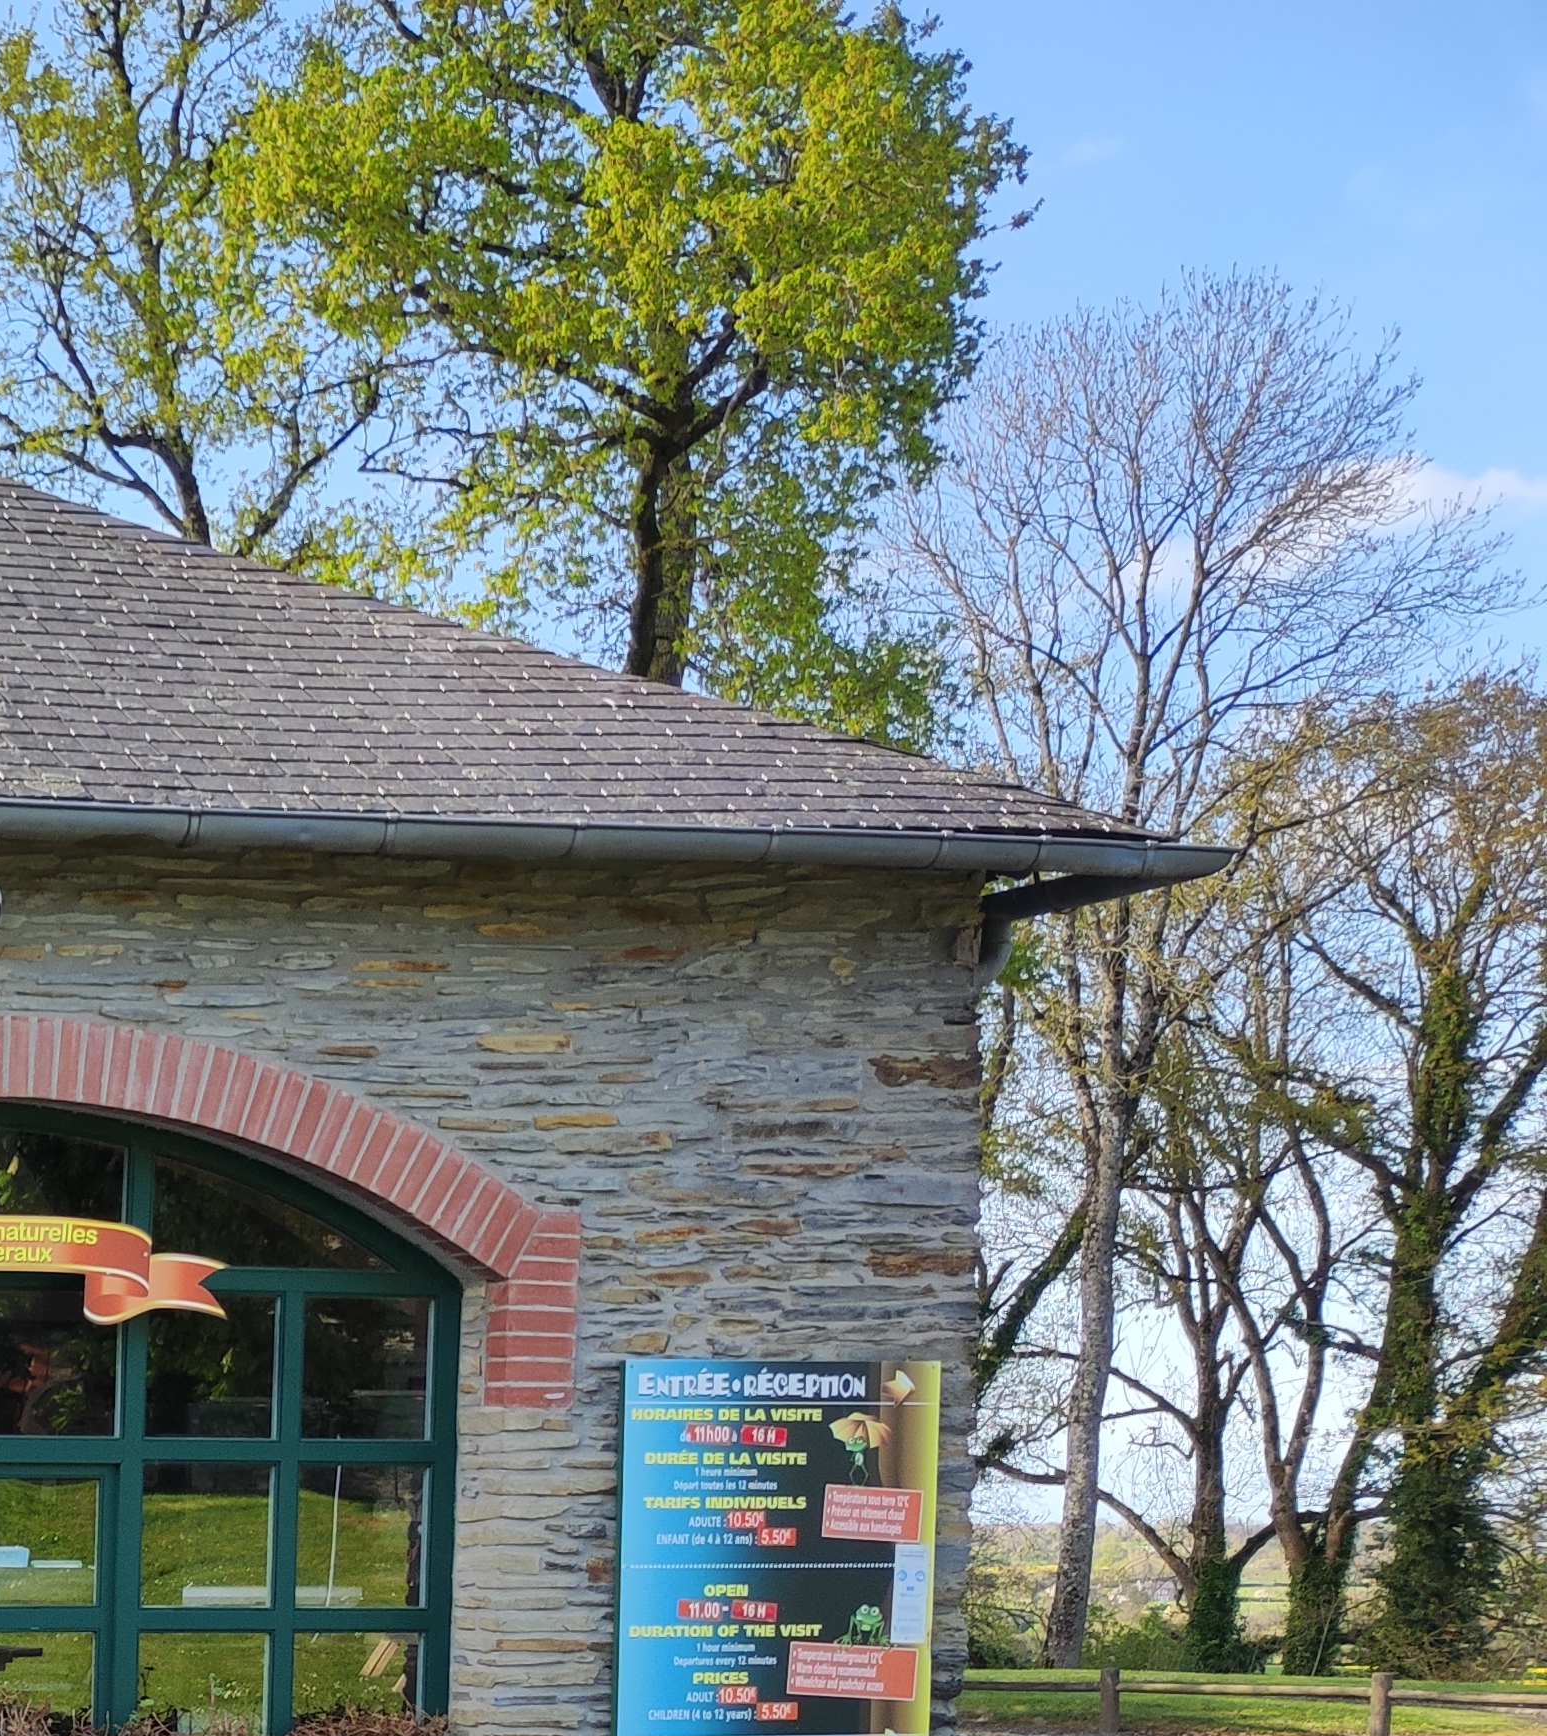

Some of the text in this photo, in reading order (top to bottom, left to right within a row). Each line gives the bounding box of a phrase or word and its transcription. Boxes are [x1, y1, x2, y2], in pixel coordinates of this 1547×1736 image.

[637, 1366, 867, 1399] ENTRÉE RÉCEPTION
[631, 1407, 823, 1422] HORAIRES DE LA VISITE
[693, 1426, 730, 1443] 11h00
[751, 1427, 764, 1442] 16
[767, 1427, 776, 1443] H
[643, 1449, 808, 1466] DURÉE DE LA VISITE
[700, 1467, 722, 1477] heure
[724, 1467, 758, 1477] minimum
[674, 1480, 699, 1492] Départ
[700, 1481, 724, 1490] toutes
[725, 1481, 736, 1490] les
[748, 1481, 778, 1490] minutes
[643, 1496, 807, 1510] TARIFS INDIVIDUELS
[688, 1516, 721, 1527] ADULTE
[657, 1533, 689, 1545] ENFANT
[692, 1533, 705, 1546] (de
[707, 1534, 713, 1545] 4
[714, 1534, 721, 1545] à
[723, 1534, 733, 1545] 12
[734, 1533, 753, 1546] ans)
[703, 1583, 749, 1598] OPEN
[688, 1601, 766, 1618] 11.00 16 H
[629, 1624, 822, 1638] DURATION OF THE VISIT
[702, 1642, 720, 1652] hour
[721, 1642, 756, 1652] minimum
[673, 1655, 777, 1668] Departures every 12 minutes
[692, 1671, 749, 1685] PRICES
[686, 1691, 713, 1703] ADULT
[648, 1708, 690, 1721] CHILDREN
[692, 1708, 700, 1721] (4
[702, 1709, 711, 1720] to
[714, 1708, 724, 1720] 12
[725, 1708, 752, 1722] years)
